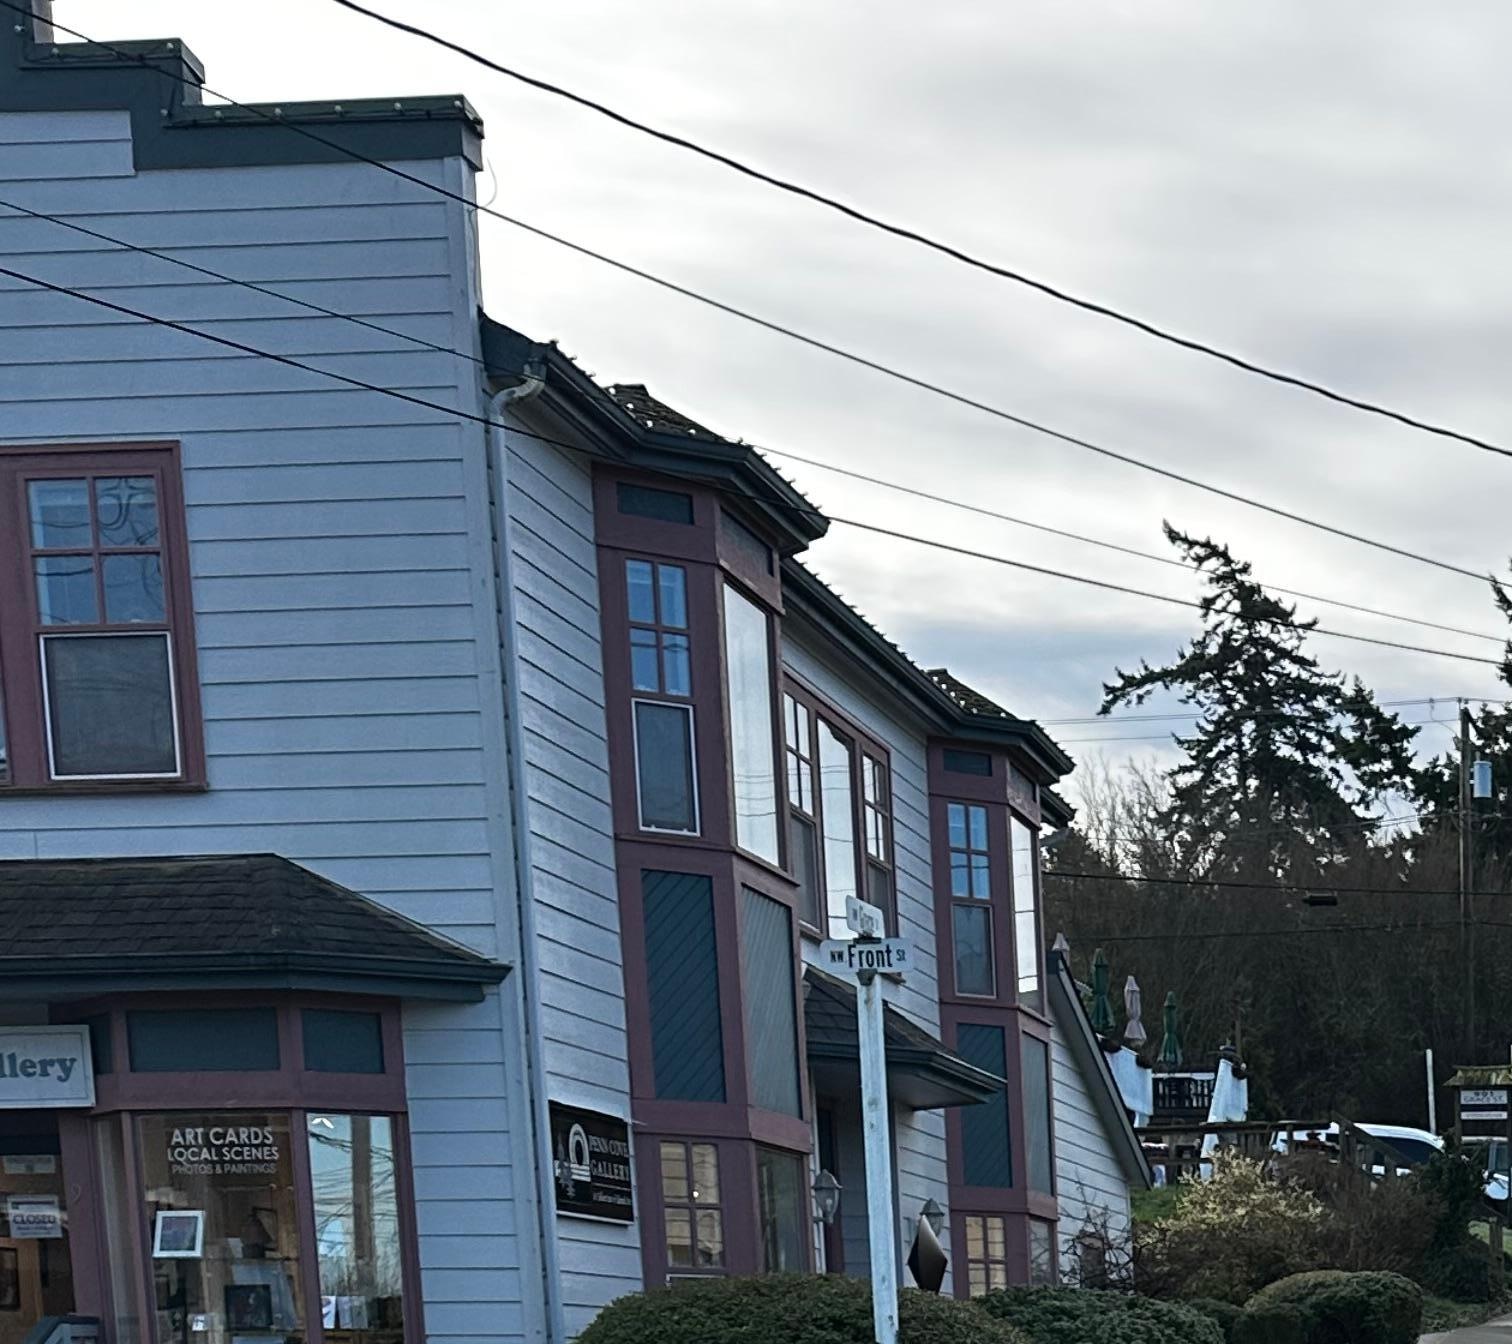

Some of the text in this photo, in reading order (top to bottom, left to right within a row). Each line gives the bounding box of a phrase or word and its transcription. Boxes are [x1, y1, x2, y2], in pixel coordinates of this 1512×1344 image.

[830, 950, 844, 963] NW
[847, 944, 893, 968] Front
[171, 1127, 273, 1145] ART CARDS
[167, 1146, 280, 1161] LOCAL SCENES
[588, 1135, 629, 1158] PENN COVE
[172, 1162, 278, 1174] PHOTOS & PAINTINGS
[590, 1159, 631, 1181] GALLERY
[13, 1214, 56, 1225] CLOSED
